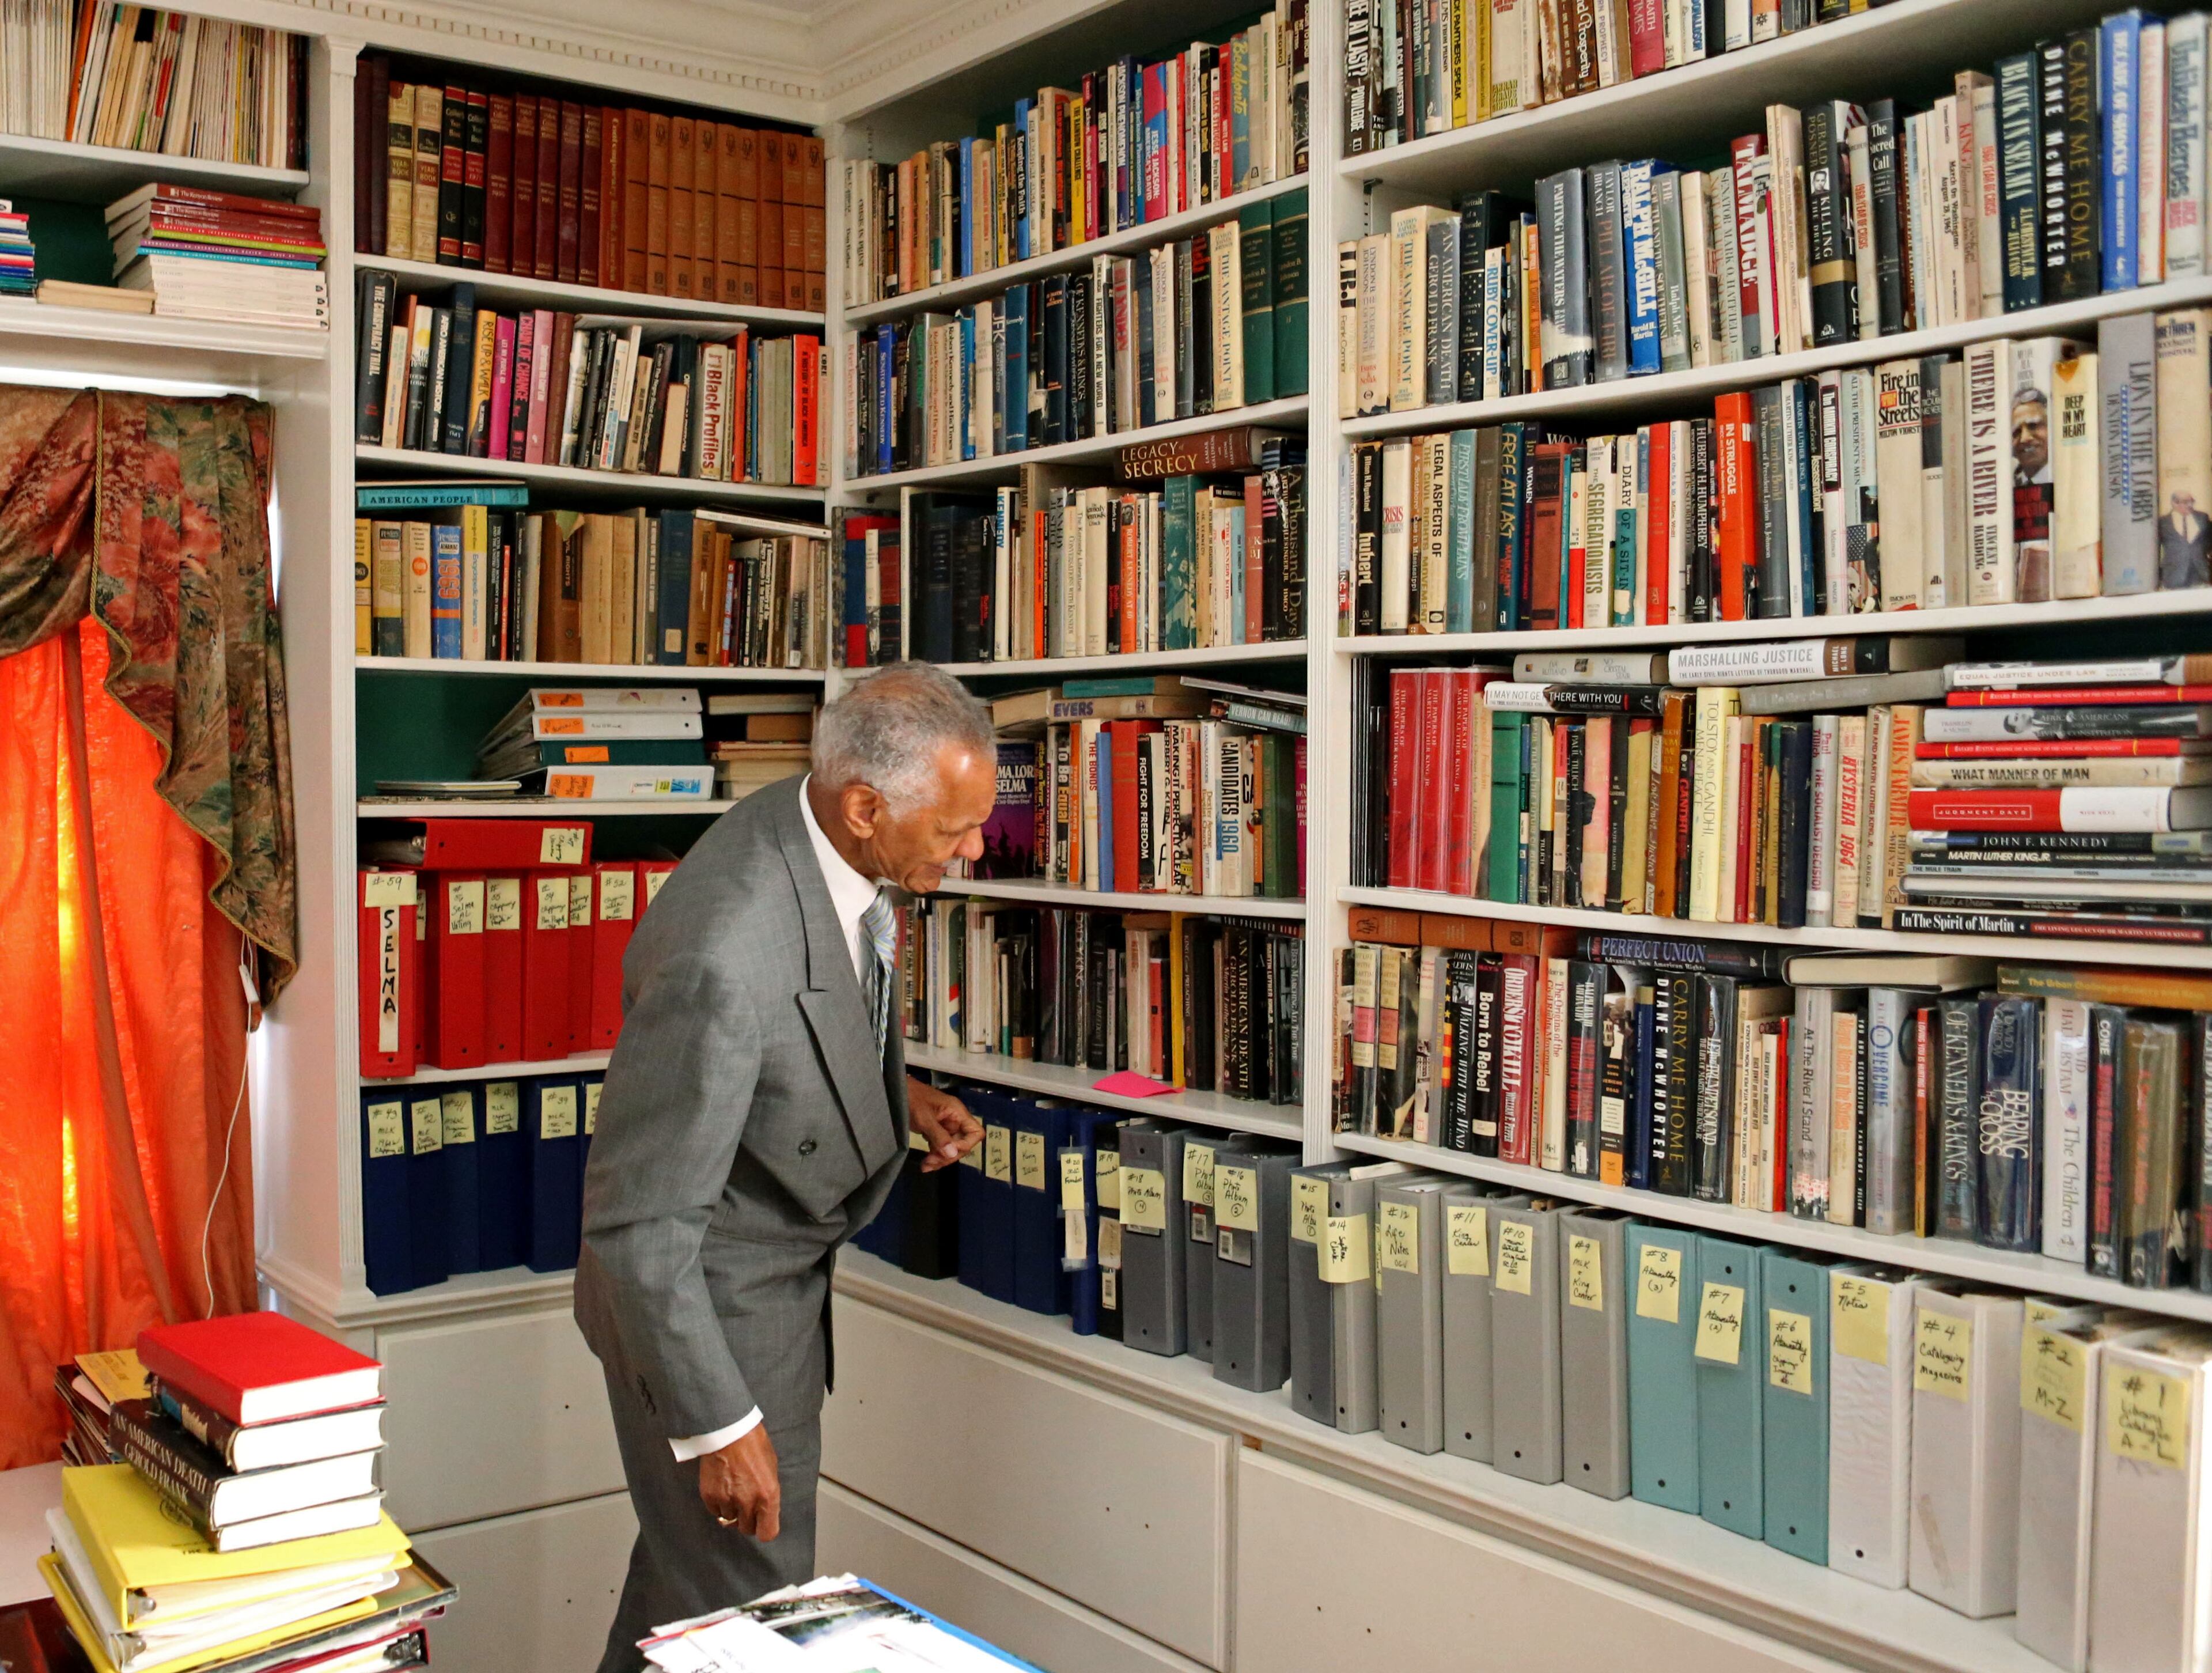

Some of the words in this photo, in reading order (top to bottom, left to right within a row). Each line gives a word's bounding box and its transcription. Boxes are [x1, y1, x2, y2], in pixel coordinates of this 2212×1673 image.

[1349, 21, 1368, 34] AT
[1453, 15, 1461, 65] PANTHERS
[1348, 37, 1368, 78] LAST?
[1232, 40, 1249, 116] Belafonte
[1453, 67, 1461, 100] SPEAK
[2001, 60, 2031, 118] BLACK
[2044, 44, 2064, 118] DIANE
[2069, 40, 2089, 125] CARRY
[2003, 119, 2029, 143] IN
[1017, 135, 1025, 170] Keeping
[2069, 134, 2090, 170] ME
[2003, 144, 2033, 202] SELMA
[1630, 160, 1654, 242] RALPH
[1735, 142, 1758, 289] TALMADGE
[2046, 130, 2066, 268] McWHORTER
[1442, 228, 1455, 253] AN
[2069, 180, 2093, 264] HOME
[1440, 255, 1454, 335] AMERICAN
[1486, 267, 1498, 300] RUBY
[1633, 243, 1657, 317] McGILL
[992, 314, 1005, 344] JFK
[1486, 301, 1498, 377] COVER-UP
[1440, 338, 1453, 391] DEATH
[1881, 372, 1903, 393] Fire
[1905, 372, 1919, 388] in
[705, 368, 722, 410] Black
[1897, 386, 1918, 404] the
[1971, 349, 1994, 420] THERE
[2065, 395, 2084, 408] DEEP
[1725, 423, 1734, 440] IN
[1878, 406, 1921, 426] Streets
[1972, 422, 1995, 441] IS
[2062, 410, 2071, 422] IN
[2073, 410, 2085, 422] MY
[2062, 422, 2086, 438] HEART
[702, 411, 721, 470] Profiles
[1123, 441, 1179, 462] LEGACY
[1501, 432, 1517, 480] FREE
[1696, 426, 1707, 472] HUBERT
[1972, 444, 1995, 457] A
[1124, 454, 1198, 479] SECRECY
[1434, 443, 1444, 481] LEGAL
[1726, 441, 1737, 495] STRUGGLE
[1501, 481, 1516, 500] AT
[1622, 464, 1633, 508] DIARY
[1972, 459, 1998, 518] RIVER
[997, 495, 1005, 549] KENNEDY
[1433, 483, 1444, 539] ASPECTS
[1500, 502, 1516, 540] LAST
[1622, 510, 1631, 528] OF
[1696, 484, 1708, 550] HUMPHREY
[1432, 542, 1442, 559] OF
[1585, 482, 1605, 595] SEGREGATIONISTS
[1620, 535, 1631, 548] A
[1975, 524, 1985, 570] HARDING
[1984, 524, 1999, 566] VINCENT
[1358, 532, 1376, 587] hubert
[438, 558, 460, 599] 1969
[1677, 652, 1759, 668] MARSHALLING
[1762, 649, 1813, 664] JUSTICE
[1054, 701, 1093, 717] EVERS
[1230, 705, 1253, 719] VERNON
[1254, 709, 1271, 721] CAN
[1271, 712, 1291, 725] READ!
[1490, 690, 1493, 700] I
[1494, 690, 1511, 699] MAY
[1512, 691, 1528, 699] NOT
[1548, 692, 1577, 702] THERE
[1579, 693, 1601, 703] WITH
[1603, 694, 1622, 704] YOU
[1706, 699, 1719, 750] TOLSTOY
[1893, 713, 1910, 767] JAMES
[1138, 758, 1147, 786] FIGHT
[1221, 741, 1240, 816] CANDIDATES
[1706, 753, 1717, 776] AND
[1816, 769, 1825, 789] THE
[1951, 769, 1986, 781] WHAT
[1988, 769, 2040, 780] MANNER
[2042, 769, 2058, 780] OF
[2061, 769, 2090, 780] MAN
[996, 778, 1027, 793] SELMA
[1139, 788, 1148, 808] FOR
[1172, 779, 1179, 788] IT
[1840, 755, 1859, 827] HYSTERIA
[1889, 770, 1910, 829] FARMER
[1814, 792, 1826, 841] SOCIALIST
[1139, 811, 1150, 860] FREEDOM
[1222, 819, 1240, 854] 1960
[1840, 834, 1855, 868] 1964
[1983, 836, 2021, 847] JOHN
[2024, 836, 2036, 847] F.
[2039, 836, 2109, 848] KENNEDY
[1812, 842, 1824, 892] DECISION
[1948, 850, 1982, 861] MARTIN
[1982, 851, 2013, 861] LUTHER
[1933, 914, 1963, 930] Spirit
[1964, 915, 1978, 930] of
[1979, 915, 2016, 933] Martin
[382, 910, 397, 1014] SELMA
[1601, 937, 1661, 960] PERFECT
[1663, 943, 1707, 963] UNION
[1604, 956, 1637, 967] Advancing
[1638, 959, 1652, 967] New
[1654, 960, 1684, 970] American
[1685, 963, 1706, 971] Rights
[1478, 991, 1494, 1027] Born
[1656, 978, 1669, 1035] DIANE
[1673, 979, 1689, 1048] CARRY
[1457, 1005, 1472, 1058] WALKING
[1478, 1029, 1491, 1045] to
[1805, 1027, 1814, 1042] At
[1476, 1047, 1492, 1092] Rebel
[1671, 1057, 1686, 1086] ME
[1803, 1043, 1814, 1065] The
[1457, 1061, 1470, 1091] WITH
[1802, 1066, 1814, 1097] River
[1457, 1093, 1469, 1116] THE
[1653, 1048, 1668, 1159] McWHORTER
[1456, 1117, 1469, 1149] WIND
[1669, 1097, 1685, 1163] HOME
[1801, 1108, 1811, 1143] Stand
[1979, 1100, 2002, 1156] CROSS
[2002, 1089, 2031, 1160] BEARING
[2064, 1126, 2079, 1157] The
[2061, 1161, 2078, 1227] Children
[129, 1423, 172, 1467] AMERICAN
[174, 1456, 209, 1494] DEATH
